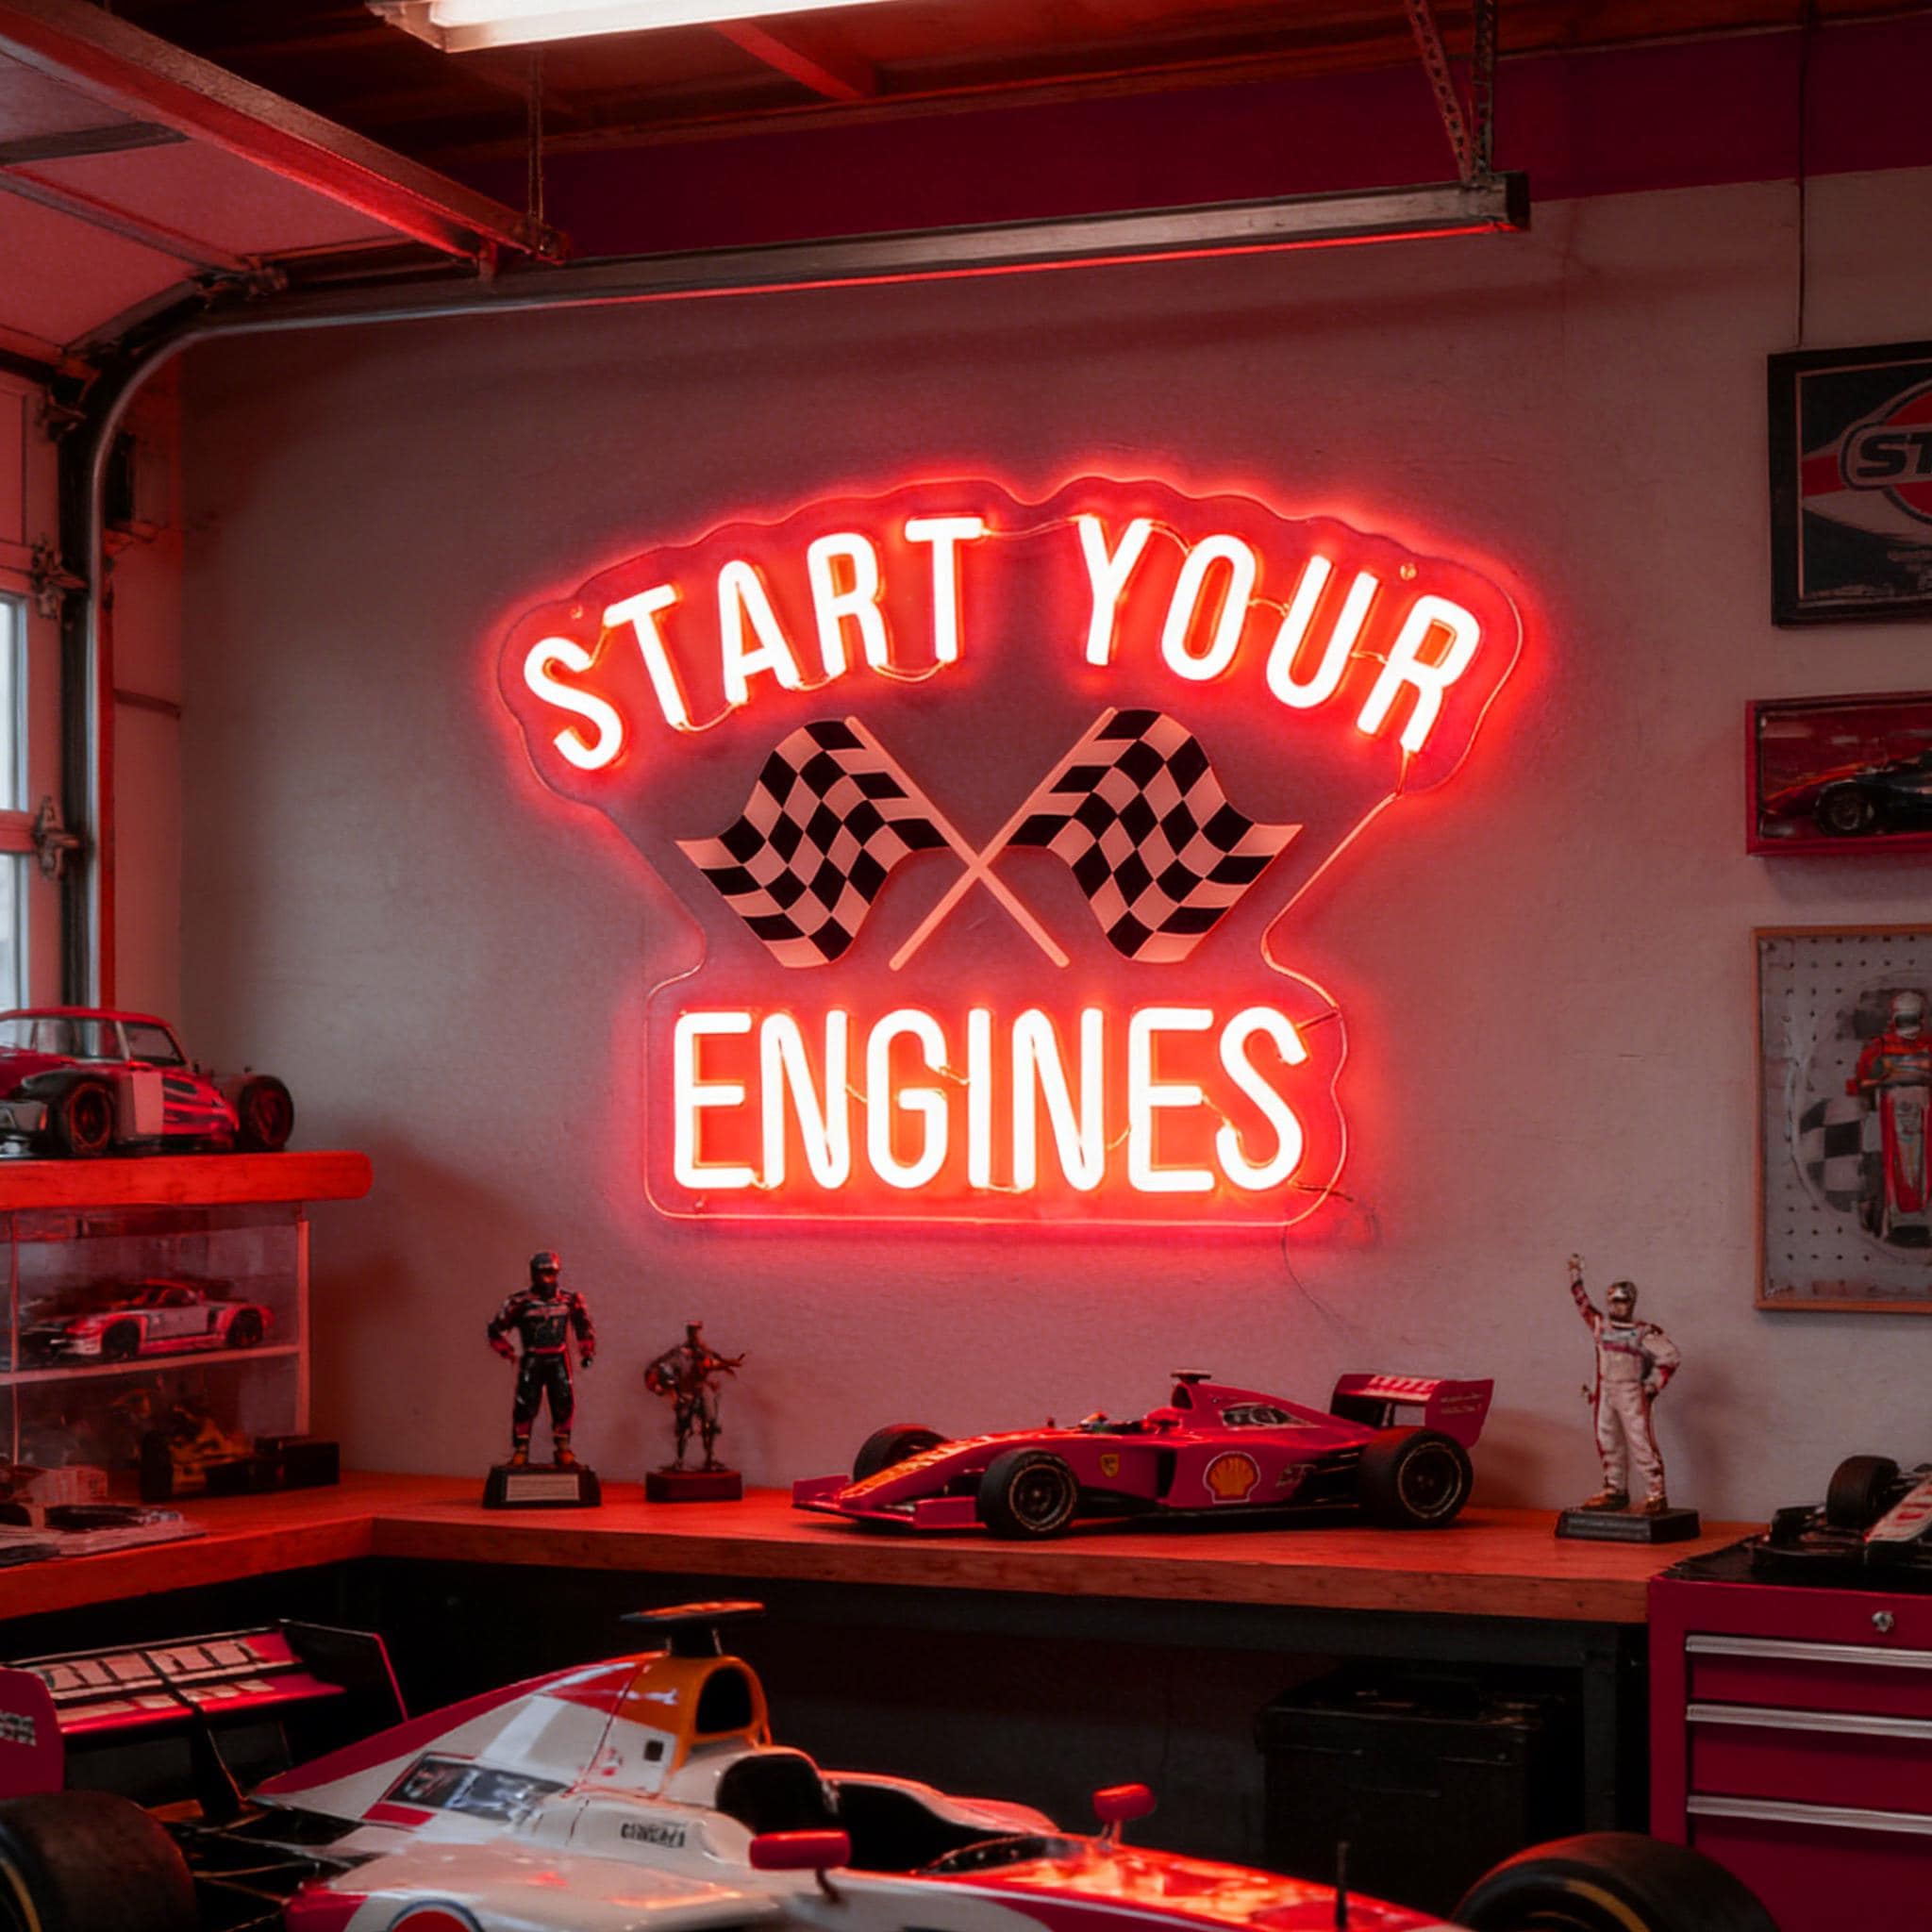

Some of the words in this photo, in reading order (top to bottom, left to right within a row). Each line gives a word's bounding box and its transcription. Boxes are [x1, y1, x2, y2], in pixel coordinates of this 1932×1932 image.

[524, 517, 985, 771] START
[1078, 513, 1481, 755] YOUR
[673, 1006, 1307, 1192] ENGINES
